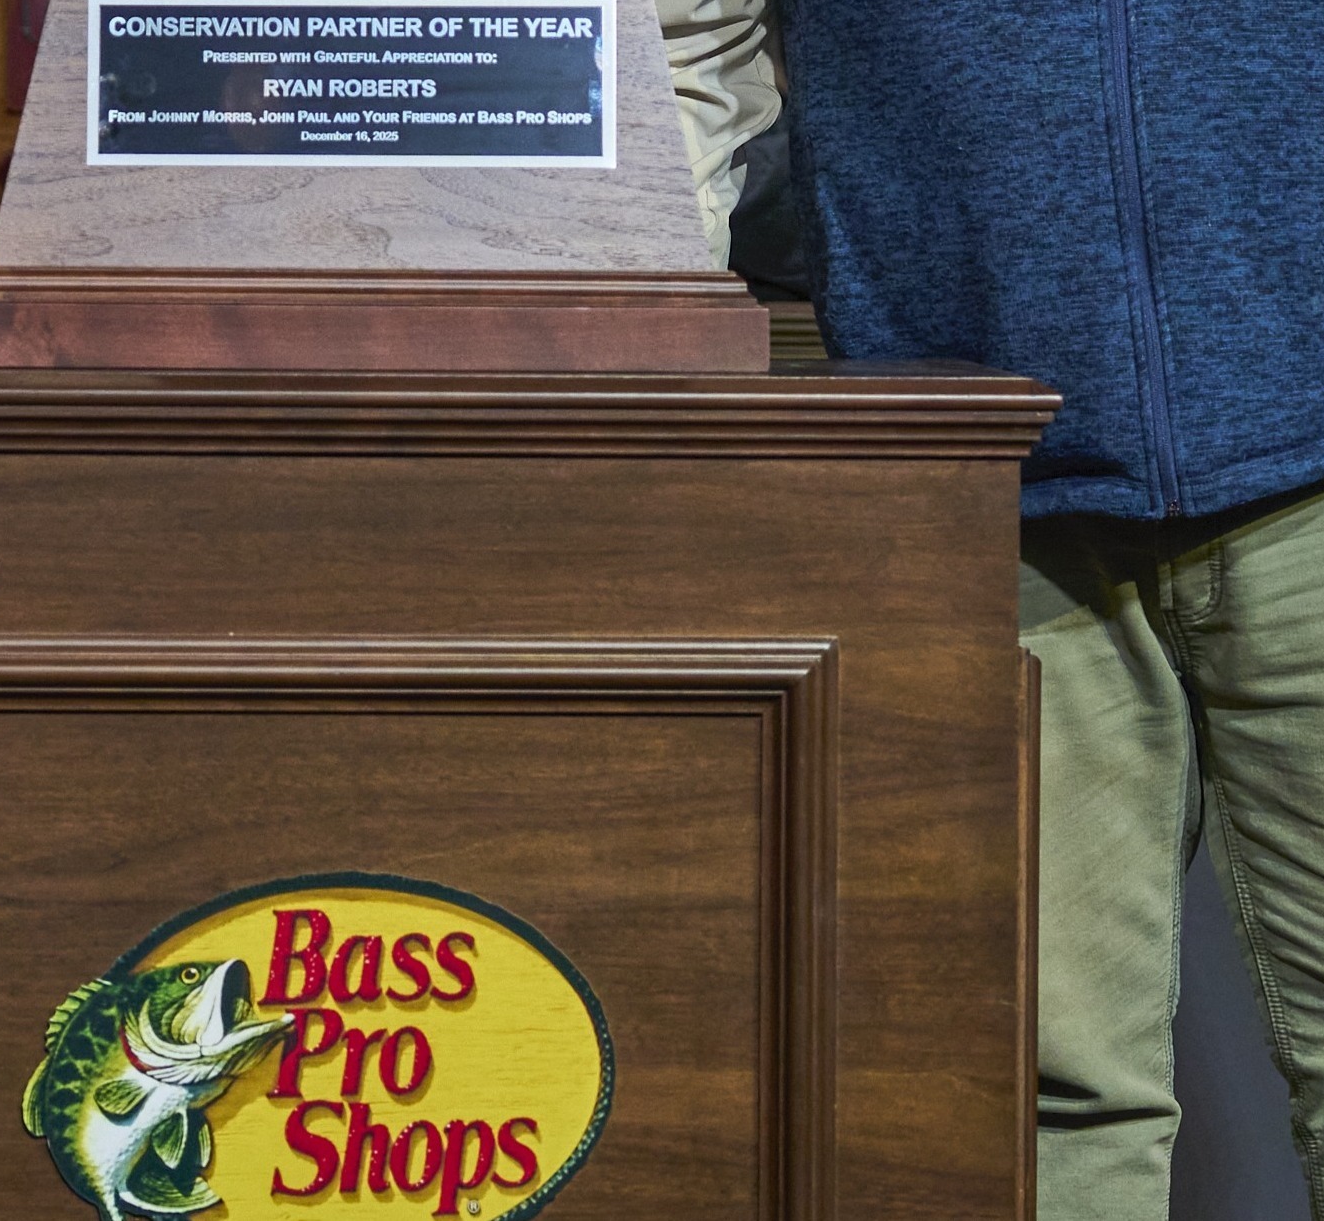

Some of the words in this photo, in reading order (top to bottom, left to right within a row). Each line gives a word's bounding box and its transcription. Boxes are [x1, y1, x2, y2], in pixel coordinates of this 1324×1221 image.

[109, 16, 299, 37] CONSERVATION
[307, 17, 422, 37] PARTNER
[429, 17, 463, 37] OF
[469, 17, 519, 37] THE
[524, 17, 593, 38] YEAR
[203, 50, 277, 63] PRESENTED
[279, 52, 310, 63] WITH
[314, 50, 380, 63] GRATEFUL
[382, 50, 472, 63] APPRECIATION
[476, 52, 497, 63] TO:
[263, 79, 322, 97] RYAN
[329, 79, 436, 97] ROBERTS
[108, 109, 145, 123] FROM
[148, 109, 200, 123] JOHNNY
[203, 109, 256, 125] MORRIS,
[259, 110, 294, 123] JOHN
[298, 110, 331, 123] PAUL
[333, 113, 360, 123] AND
[363, 110, 399, 124] YOUR
[402, 110, 456, 124] FRIENDS
[459, 112, 475, 124] AT
[478, 110, 513, 124] BASS
[516, 110, 545, 124] PRO
[547, 110, 592, 124] SHOPS
[301, 130, 353, 142] December
[355, 130, 370, 143] 16,
[372, 130, 399, 142] 2025
[258, 908, 476, 1005] Bass
[268, 1007, 432, 1099] Pro
[270, 1100, 540, 1217] Shops
